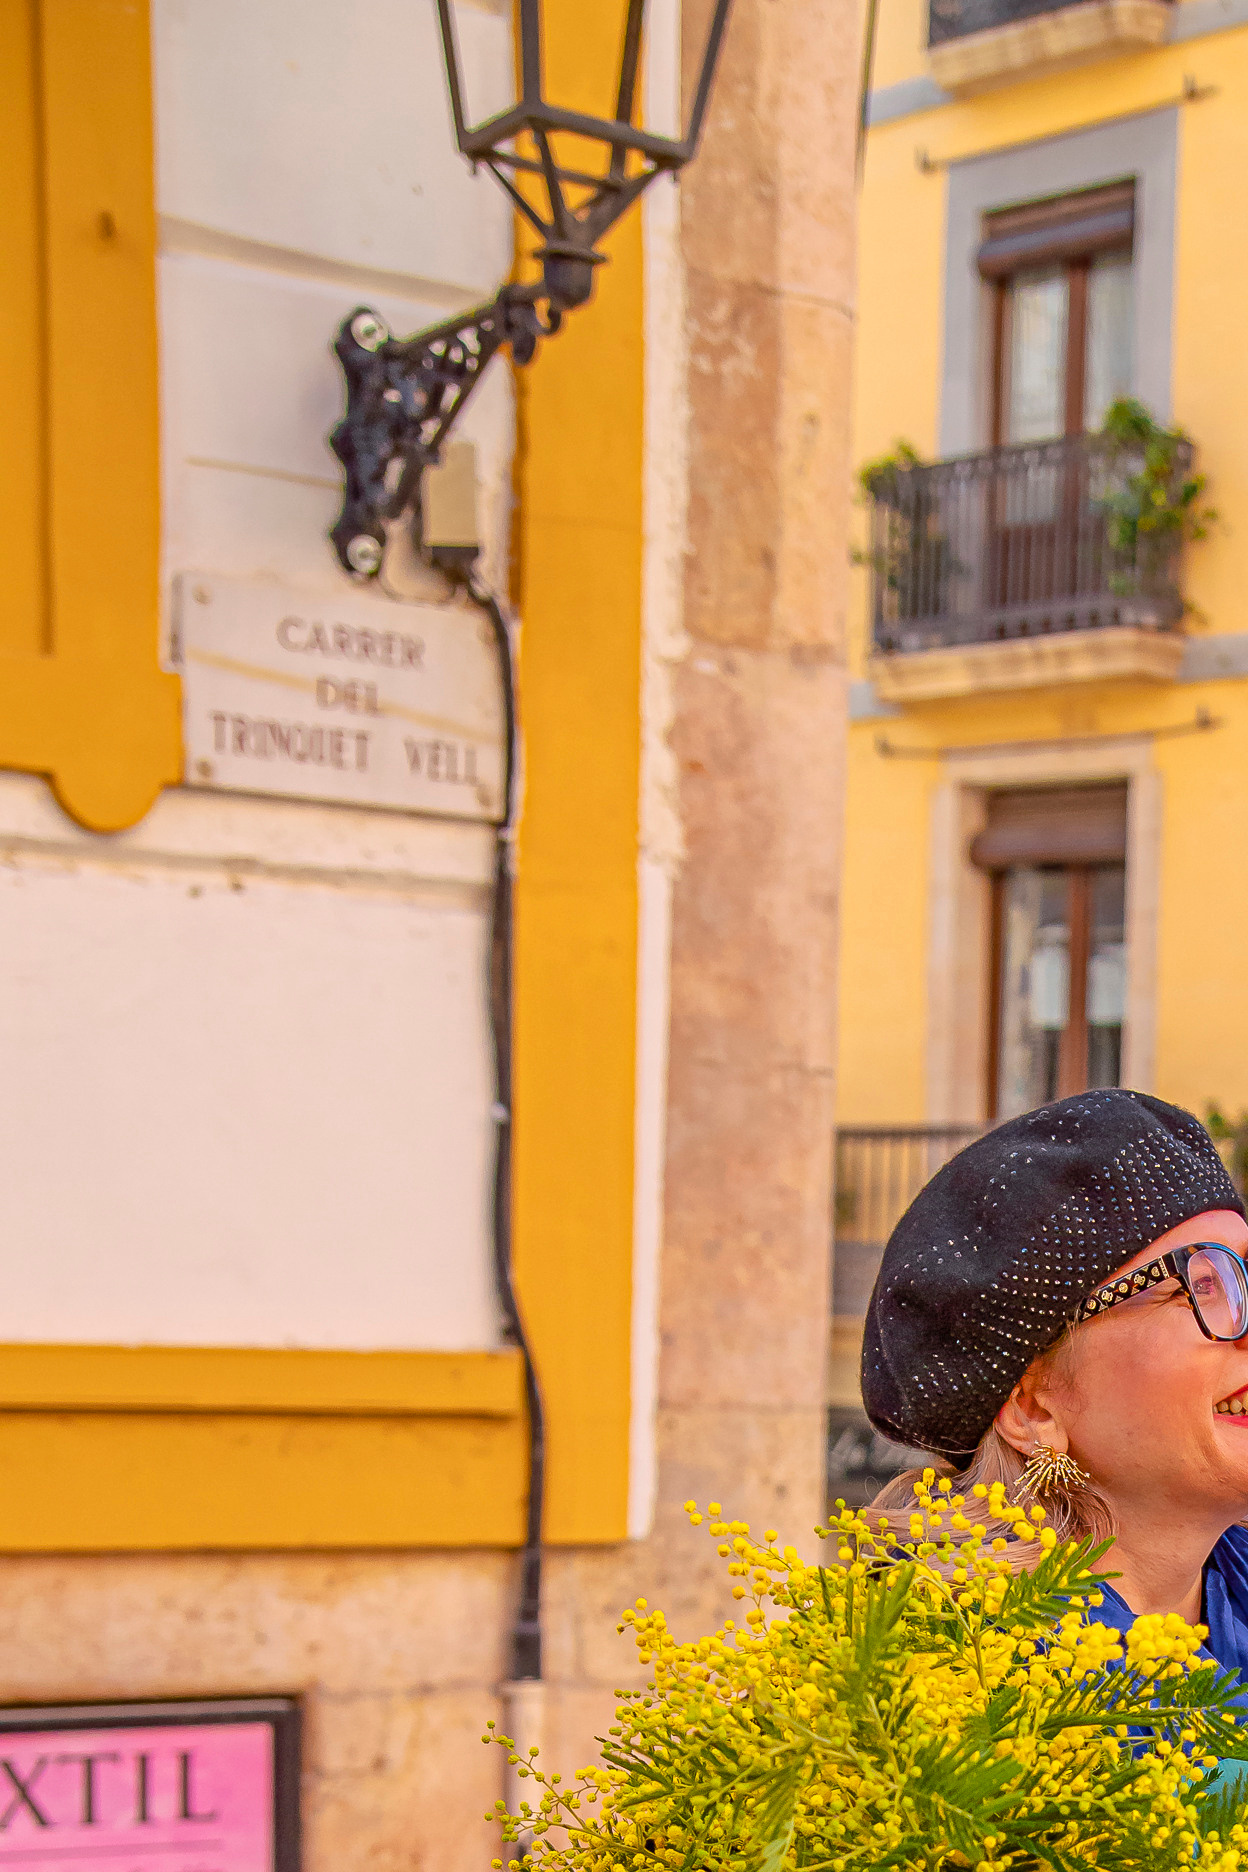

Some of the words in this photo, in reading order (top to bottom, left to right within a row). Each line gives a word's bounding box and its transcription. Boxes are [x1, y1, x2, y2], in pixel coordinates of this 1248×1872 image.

[275, 614, 427, 669] CARRER
[315, 675, 381, 718] DEL
[210, 709, 373, 773] TRINQUET
[404, 738, 481, 788] VELL
